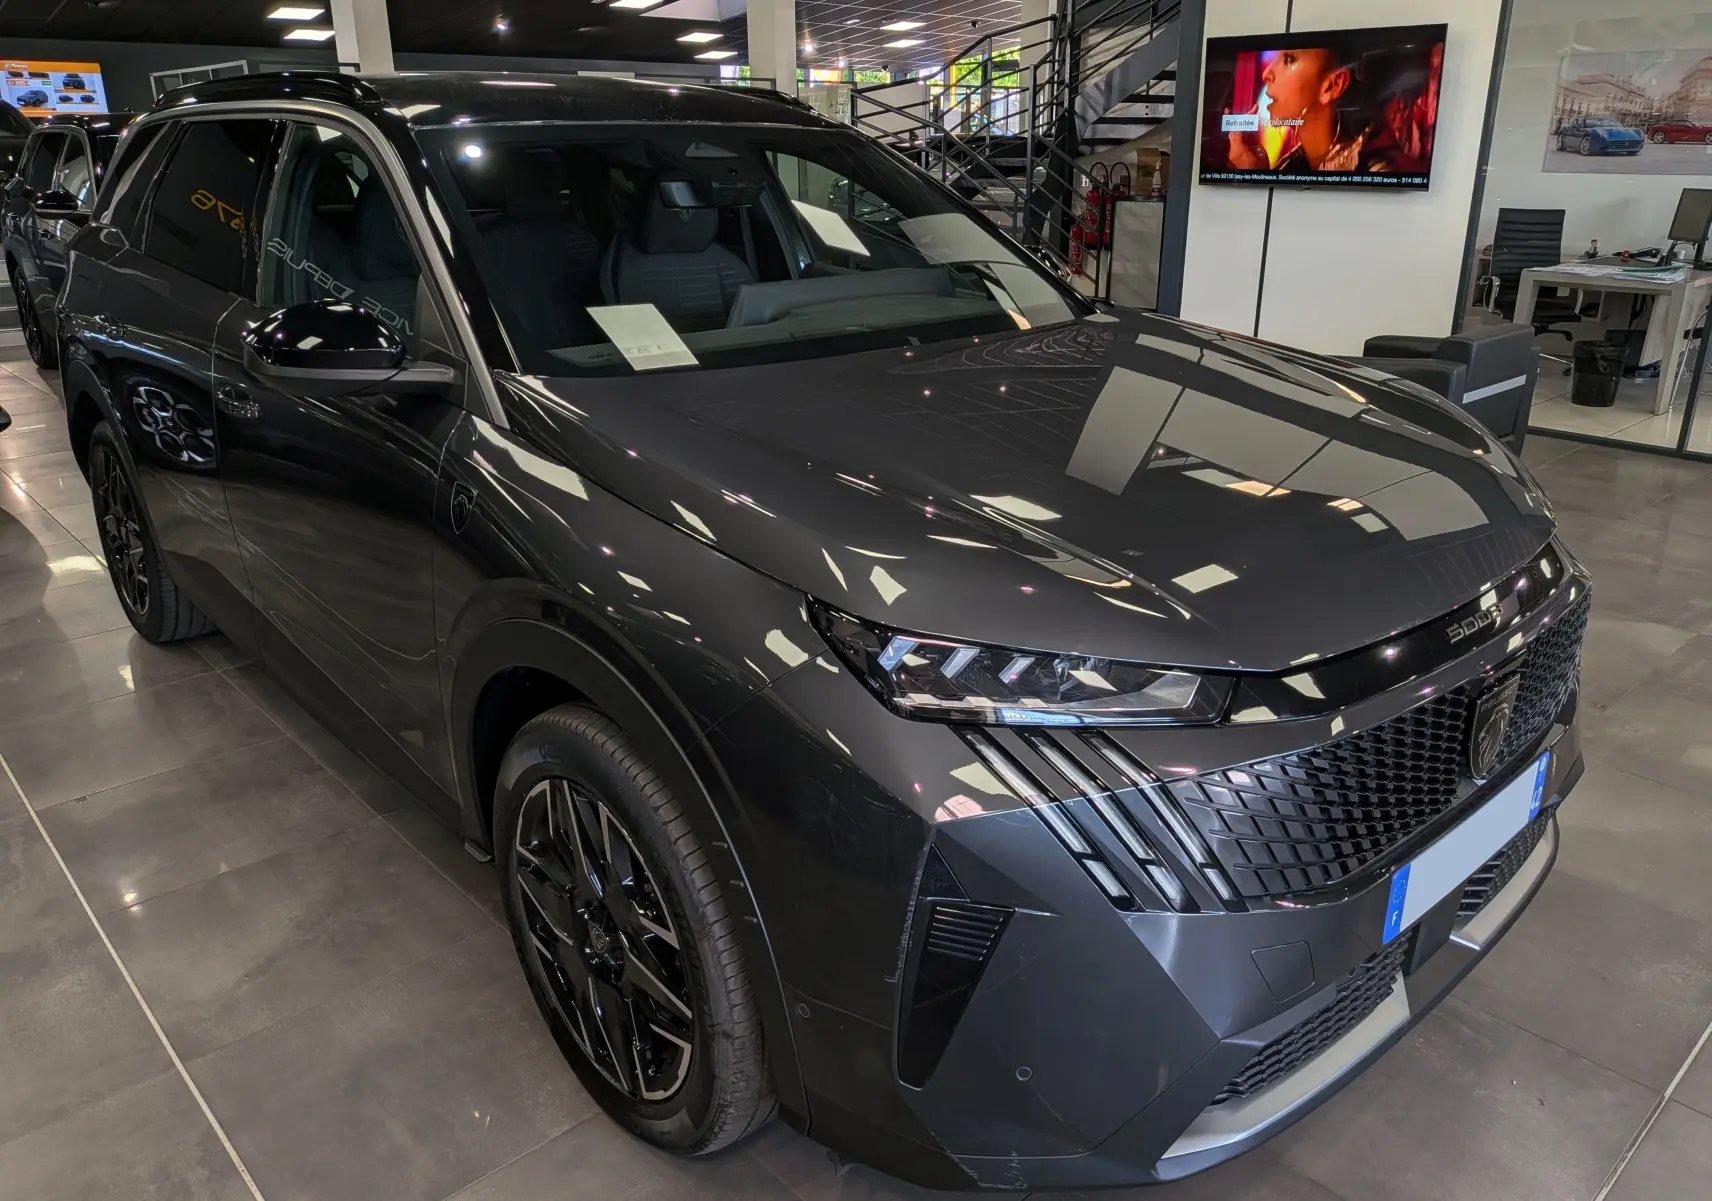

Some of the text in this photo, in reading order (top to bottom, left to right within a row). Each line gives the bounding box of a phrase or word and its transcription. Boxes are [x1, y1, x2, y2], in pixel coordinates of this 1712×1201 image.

[1225, 118, 1255, 127] Retraitée
[1268, 116, 1305, 127] colocataire
[1445, 603, 1504, 644] 5008
[1391, 909, 1399, 927] F
